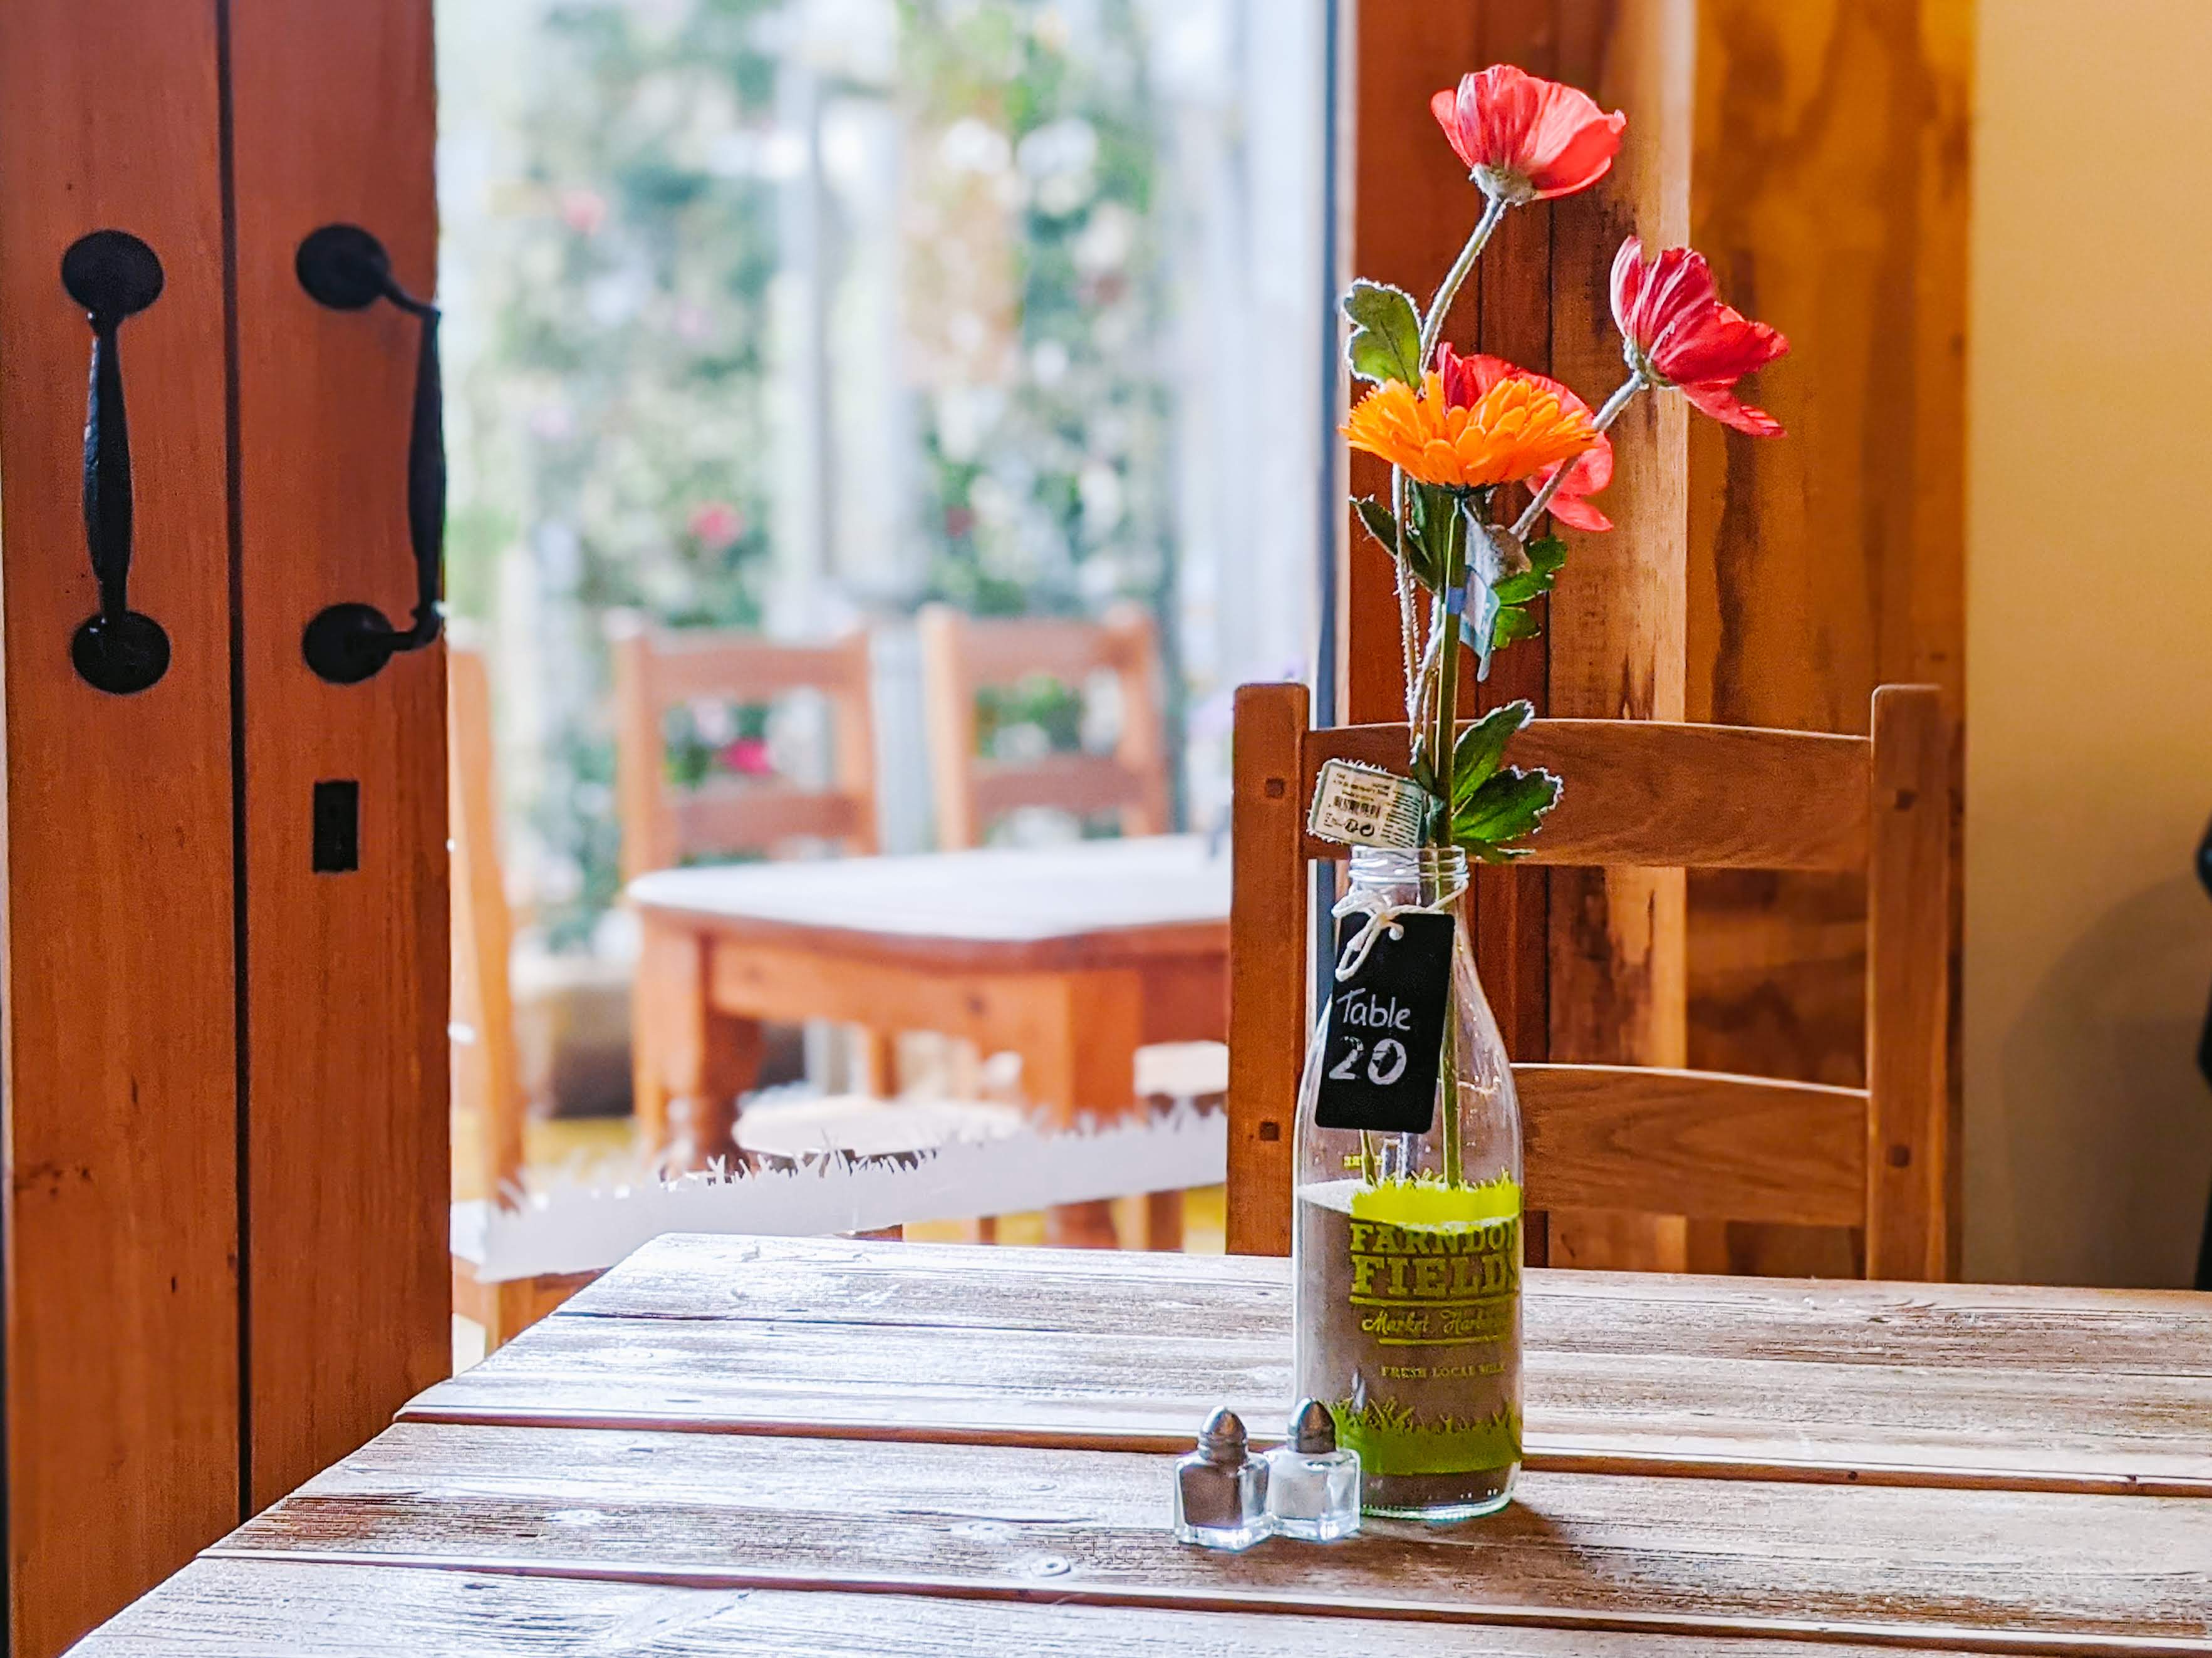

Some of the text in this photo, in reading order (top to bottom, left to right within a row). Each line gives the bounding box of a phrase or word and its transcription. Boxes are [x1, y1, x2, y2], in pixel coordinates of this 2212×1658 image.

[1336, 987, 1411, 1031] Table
[1328, 1035, 1408, 1085] 20
[1381, 1365, 1426, 1379] FRESH
[1431, 1365, 1476, 1379] LOCAL
